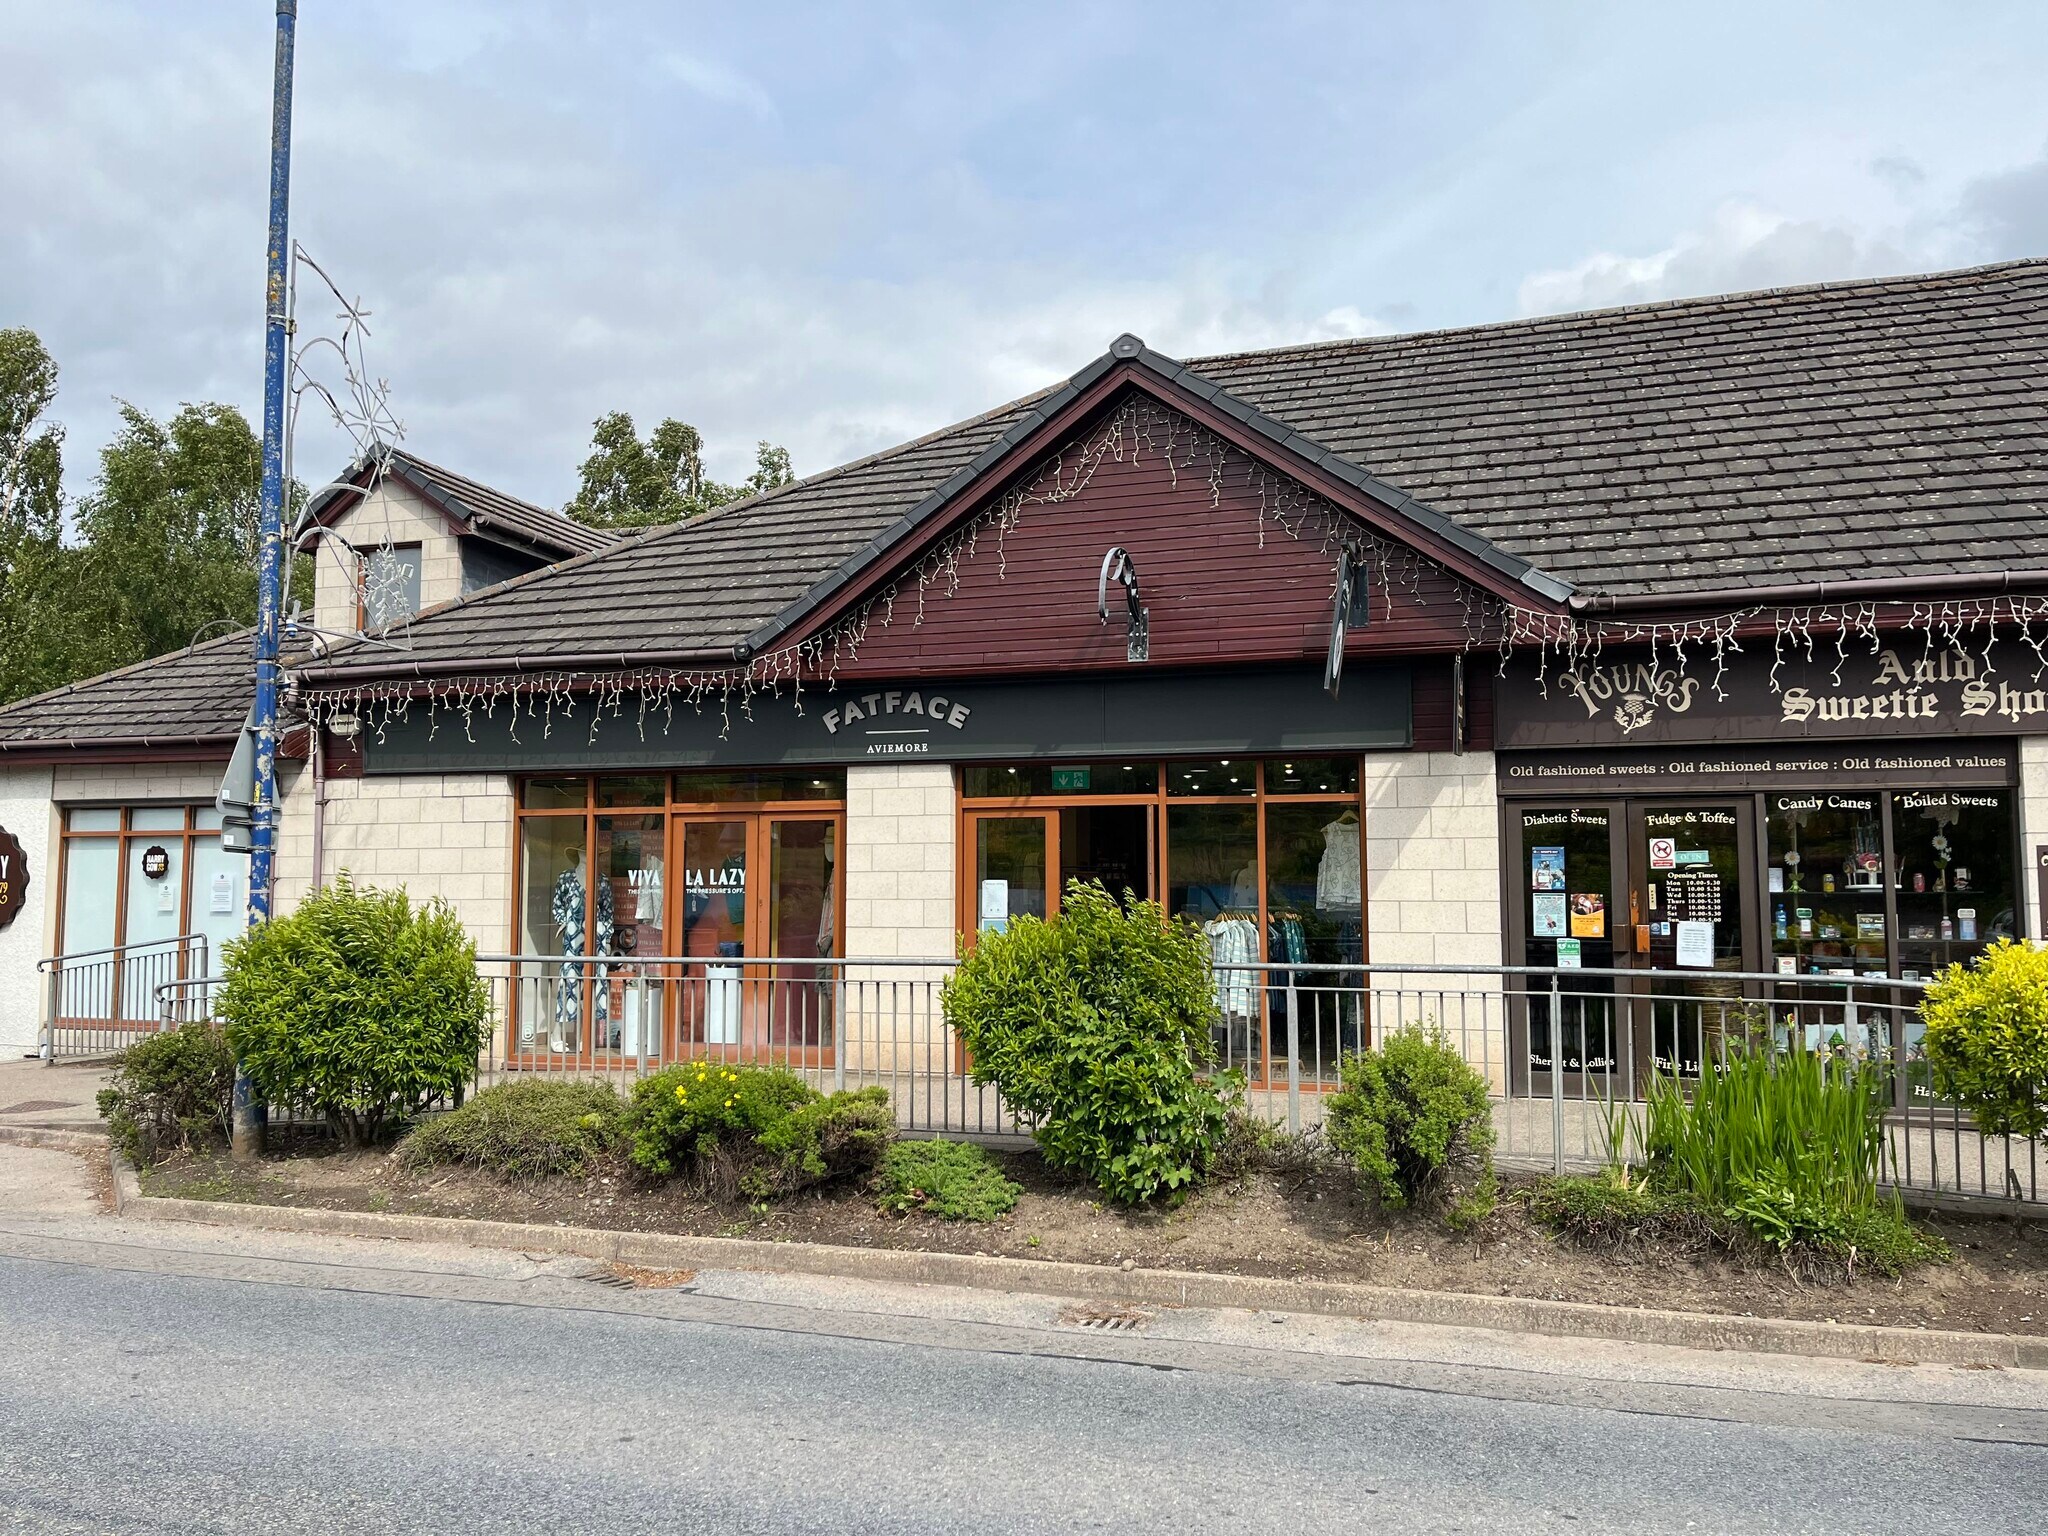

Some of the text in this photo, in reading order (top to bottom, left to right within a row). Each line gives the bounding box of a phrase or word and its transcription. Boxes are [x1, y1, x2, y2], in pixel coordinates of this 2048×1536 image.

[1872, 649, 1976, 684] Auld
[1780, 680, 2048, 723] Sweetie Sho
[822, 691, 971, 734] FATFACE
[867, 743, 928, 754] AVIEMORE
[1510, 766, 1534, 777] Old
[1538, 764, 1605, 776] fashioned
[1609, 763, 1656, 775] sweets
[1669, 762, 1695, 773] Old
[1699, 760, 1771, 773] fashioned
[1775, 759, 1829, 771] service
[1842, 758, 1869, 770] Old
[1874, 757, 1951, 769] fashioned
[1956, 755, 2006, 767] values
[1778, 795, 1872, 811] Candy Canes
[1902, 793, 1998, 808] Boiled Sweets
[1523, 812, 1607, 826] Diabetic Sweets
[1648, 811, 1736, 827] Fudge & Toffee
[628, 869, 746, 886] VIVA LA LAZY
[1667, 871, 1697, 879] Opening
[1529, 1054, 1615, 1067] Shert & ollis
